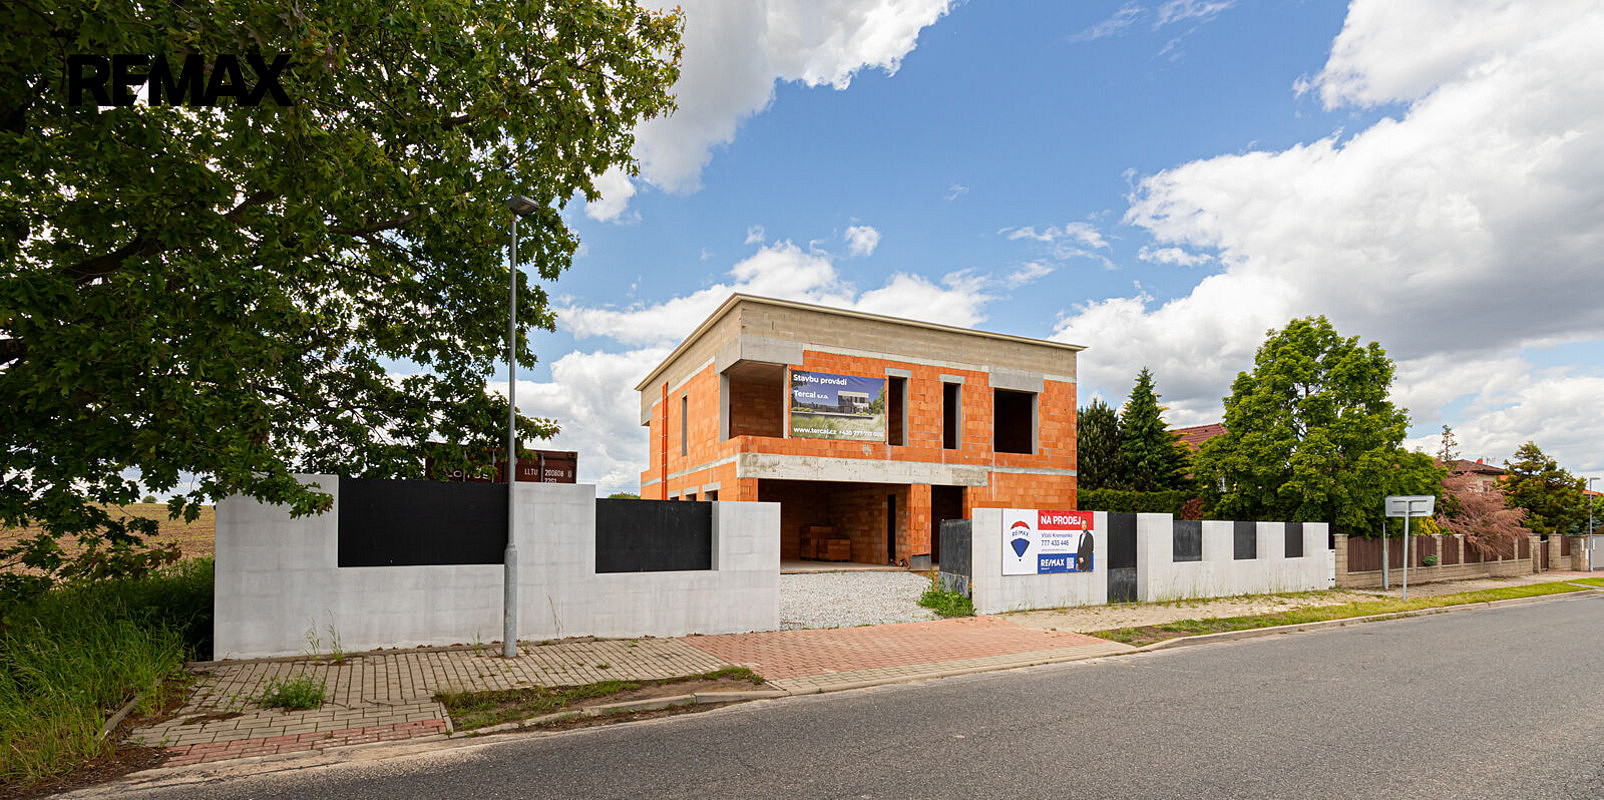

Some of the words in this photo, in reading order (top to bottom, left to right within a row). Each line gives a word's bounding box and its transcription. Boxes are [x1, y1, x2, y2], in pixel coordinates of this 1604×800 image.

[793, 373, 819, 383] Stavbu
[820, 377, 848, 386] provádí
[793, 389, 816, 399] Tercal
[793, 427, 837, 435] www.tercal.cz
[524, 467, 539, 476] LLTU
[1040, 515, 1052, 525] NA
[1053, 515, 1082, 525] PRODEJ
[1040, 558, 1065, 567] RE/MAX
